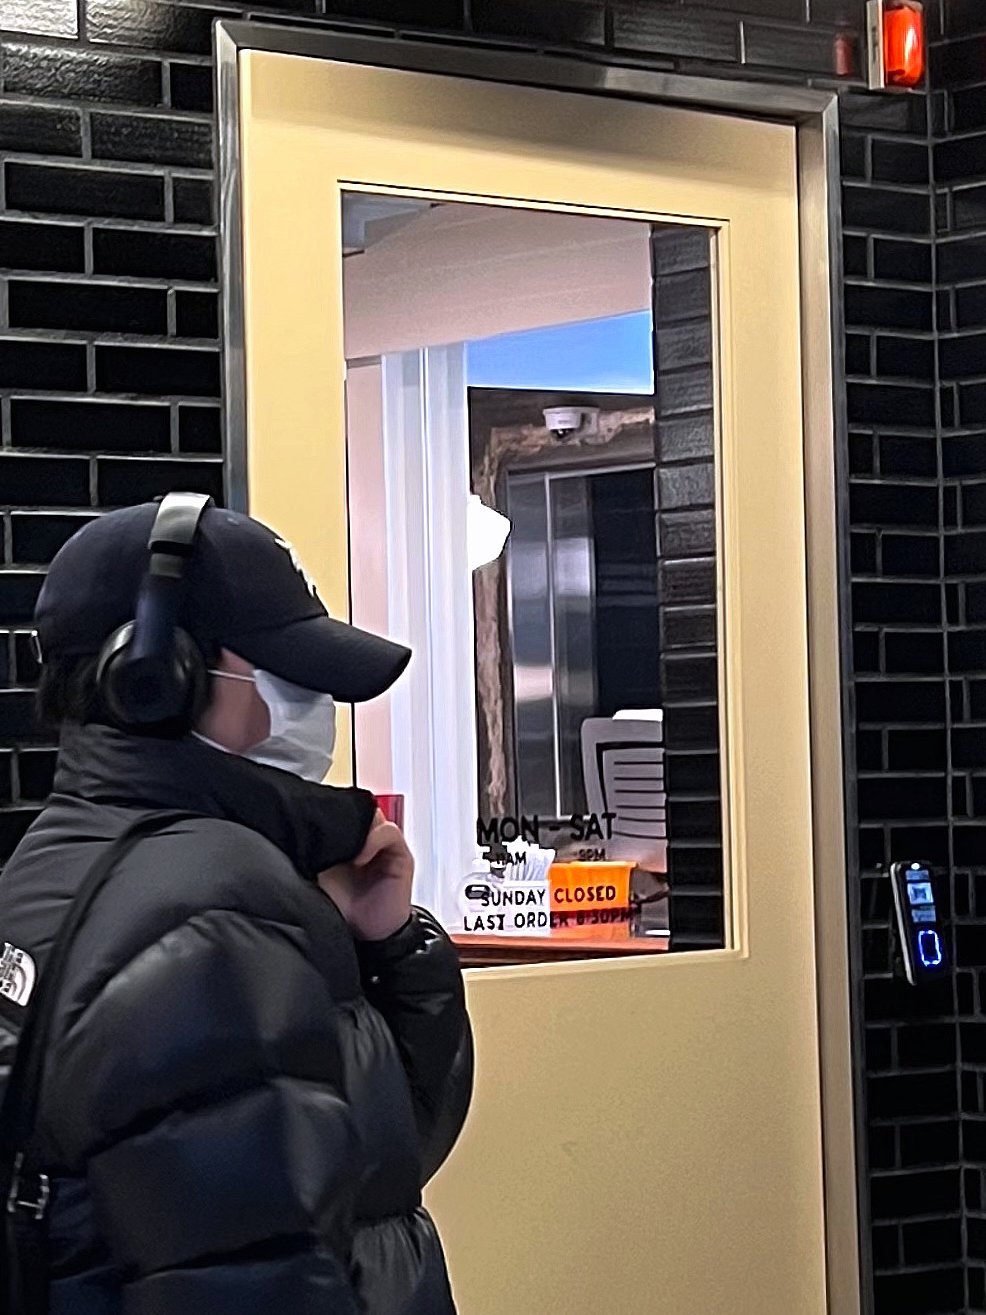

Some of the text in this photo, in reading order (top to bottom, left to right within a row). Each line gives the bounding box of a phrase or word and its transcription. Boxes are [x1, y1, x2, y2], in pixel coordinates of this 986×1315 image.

[477, 814, 539, 842] MON
[570, 813, 616, 840] SAT
[481, 885, 616, 906] SUNDAY CLOSED
[464, 914, 505, 931] LAST
[514, 911, 568, 929] ORDER
